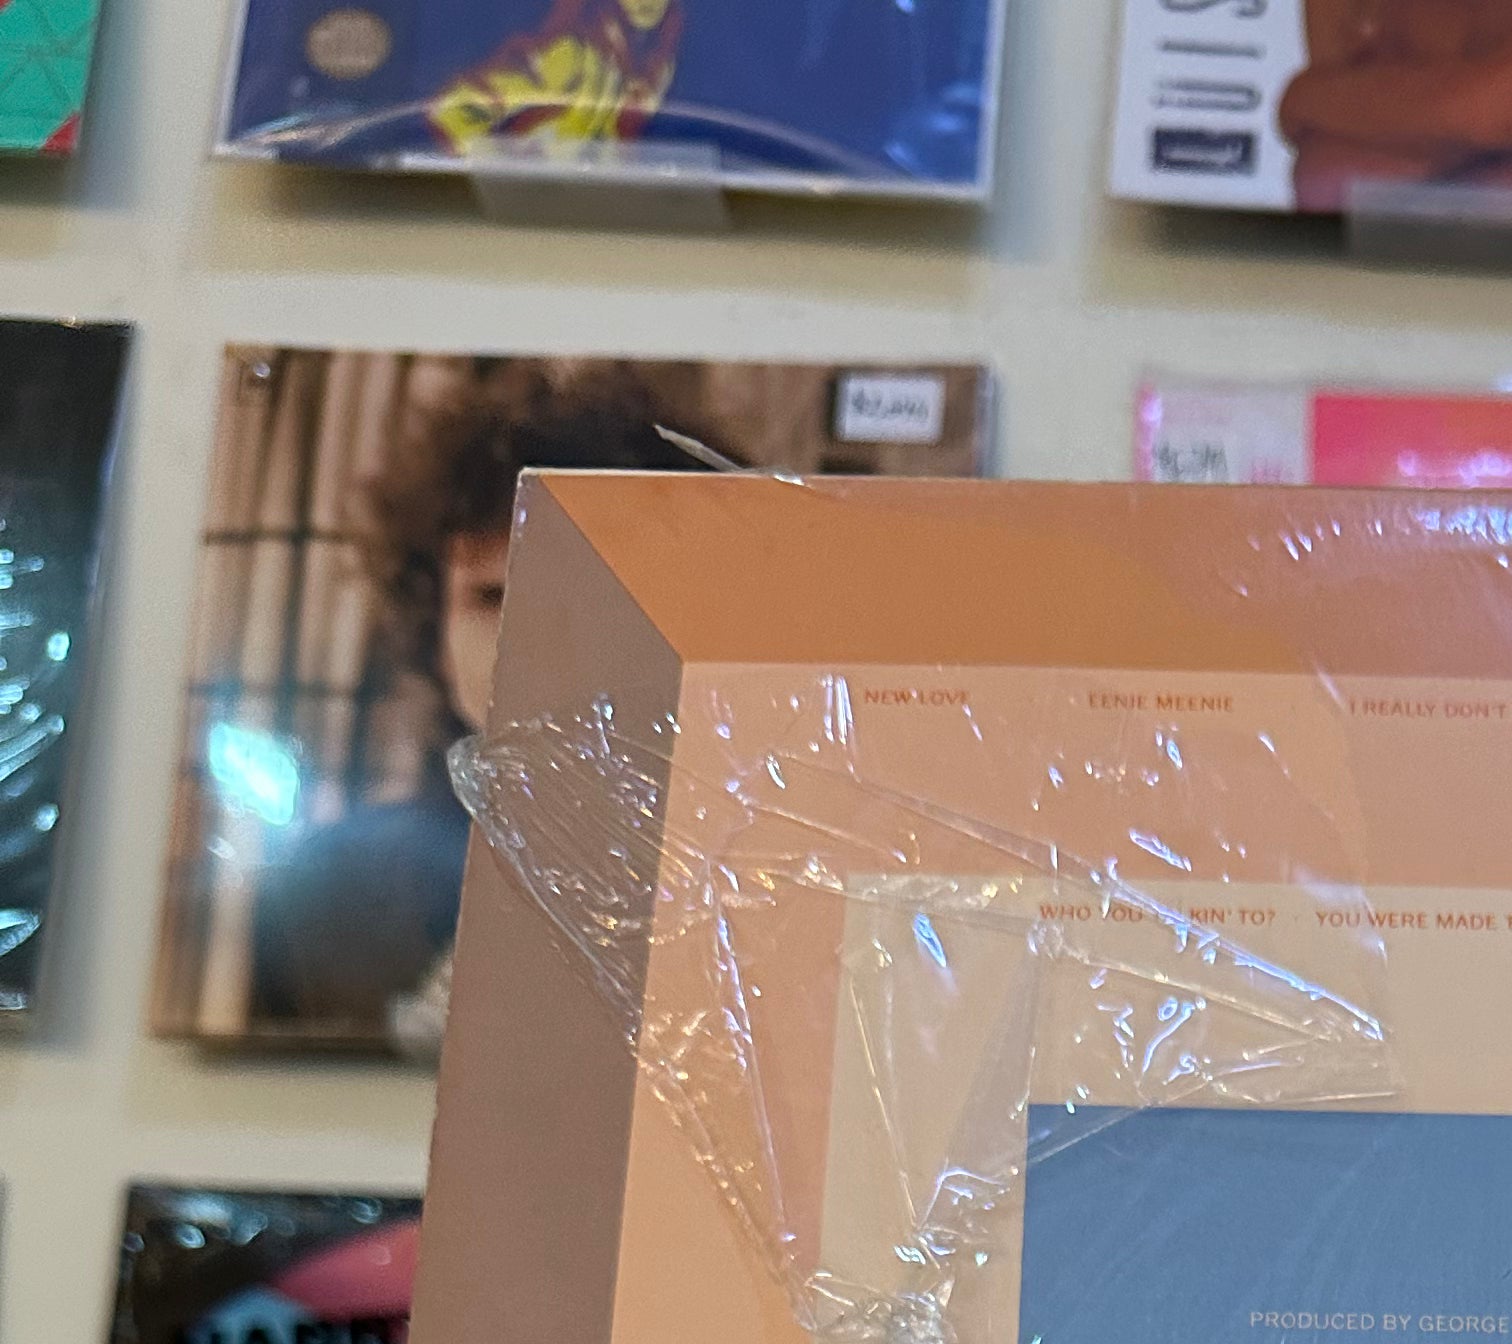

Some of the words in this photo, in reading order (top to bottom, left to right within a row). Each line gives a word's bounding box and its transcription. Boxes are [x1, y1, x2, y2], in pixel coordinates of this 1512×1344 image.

[864, 687, 912, 705] NEW
[917, 689, 970, 706] LOVE
[1087, 690, 1148, 709] EENIE
[1155, 693, 1234, 712] MEENIE
[1349, 700, 1357, 716] I
[1362, 701, 1436, 719] REALLY
[1444, 703, 1506, 720] DON'T
[1040, 904, 1092, 922] WHO
[1101, 905, 1143, 923] OU
[1238, 909, 1277, 926] TO?
[1315, 908, 1362, 929] YOU
[1366, 909, 1428, 931] WERE
[1436, 911, 1498, 932] MADE
[1250, 1311, 1376, 1331] PRODUCED
[1383, 1313, 1412, 1332] BY
[1418, 1314, 1510, 1335] GEORGE
